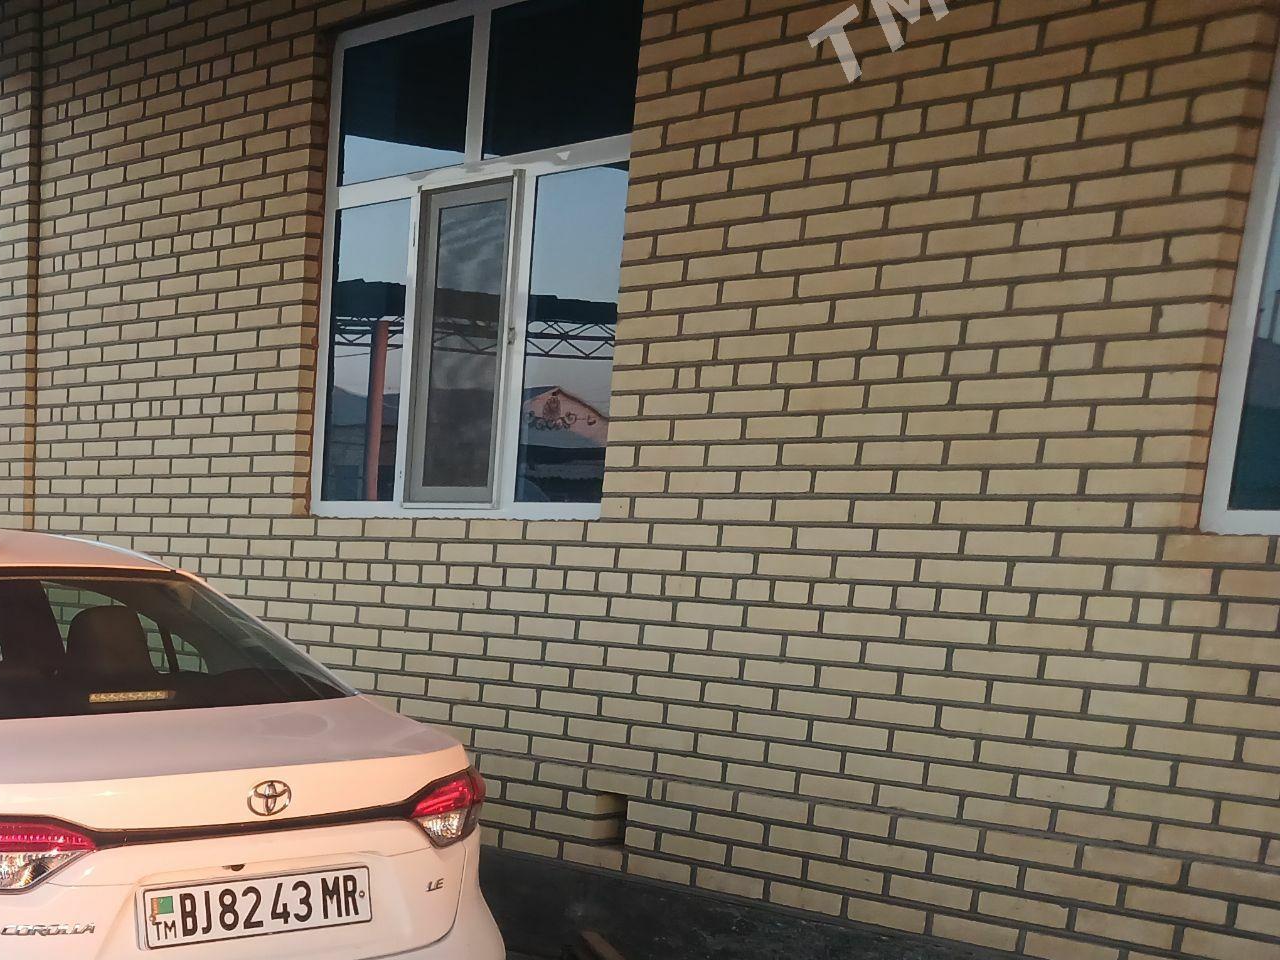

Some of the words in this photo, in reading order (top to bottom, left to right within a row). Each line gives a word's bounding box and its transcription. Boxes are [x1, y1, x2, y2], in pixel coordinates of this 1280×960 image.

[425, 877, 445, 893] LE
[0, 923, 96, 937] COROLLA
[154, 919, 177, 941] TM
